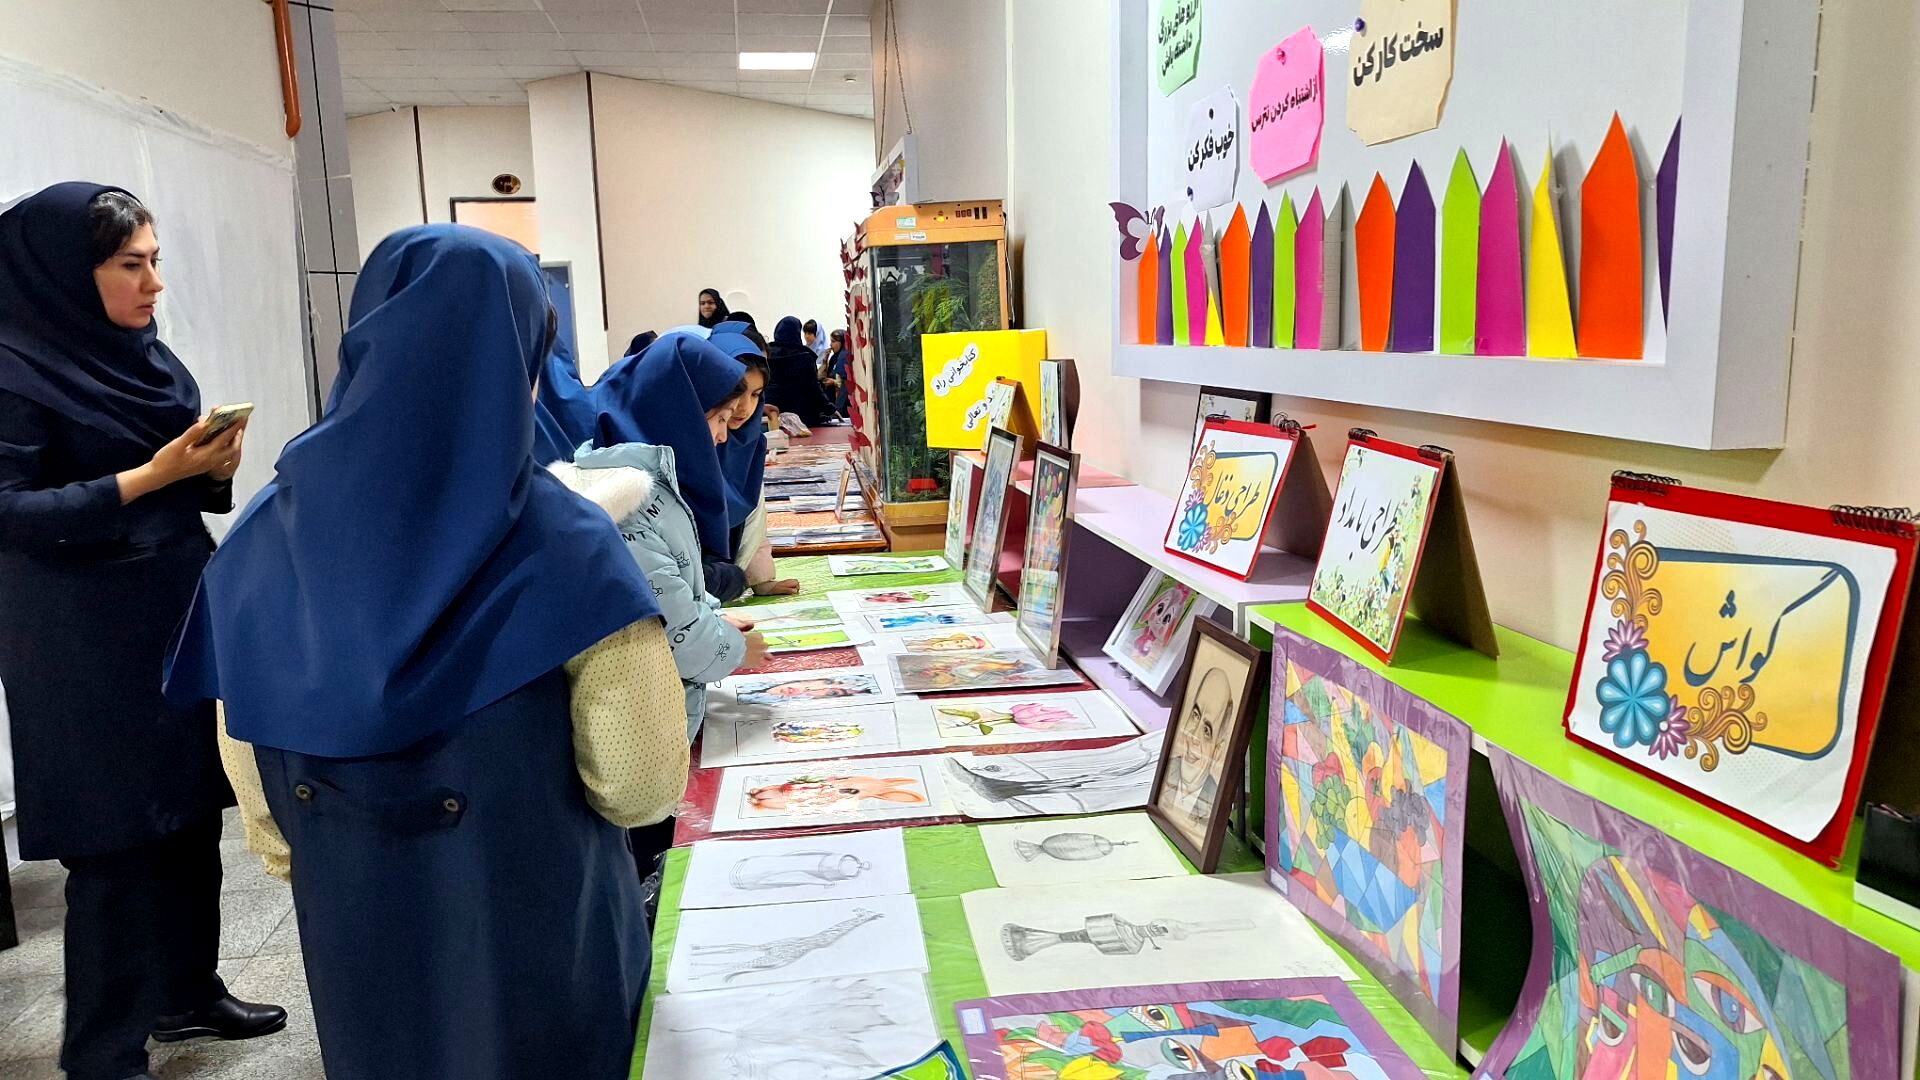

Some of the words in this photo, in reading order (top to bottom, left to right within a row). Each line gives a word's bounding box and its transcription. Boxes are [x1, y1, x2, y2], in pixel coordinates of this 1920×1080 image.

[1375, 32, 1398, 83] کار
[1399, 21, 1444, 62] سخت
[1353, 41, 1376, 87] کن
[1290, 78, 1312, 110] اشتباه
[1312, 74, 1319, 103] از
[1251, 104, 1270, 133] نترس
[1270, 92, 1290, 123] کردن
[1187, 139, 1200, 172] کن
[1200, 128, 1215, 170] فکر
[1214, 122, 1235, 161] خوب
[935, 379, 947, 390] راه
[948, 348, 977, 384] کتابخوانی
[967, 406, 981, 429] تعالی
[1225, 480, 1262, 519] طراحی
[1337, 485, 1357, 529] مداد
[1360, 498, 1400, 555] طراحی
